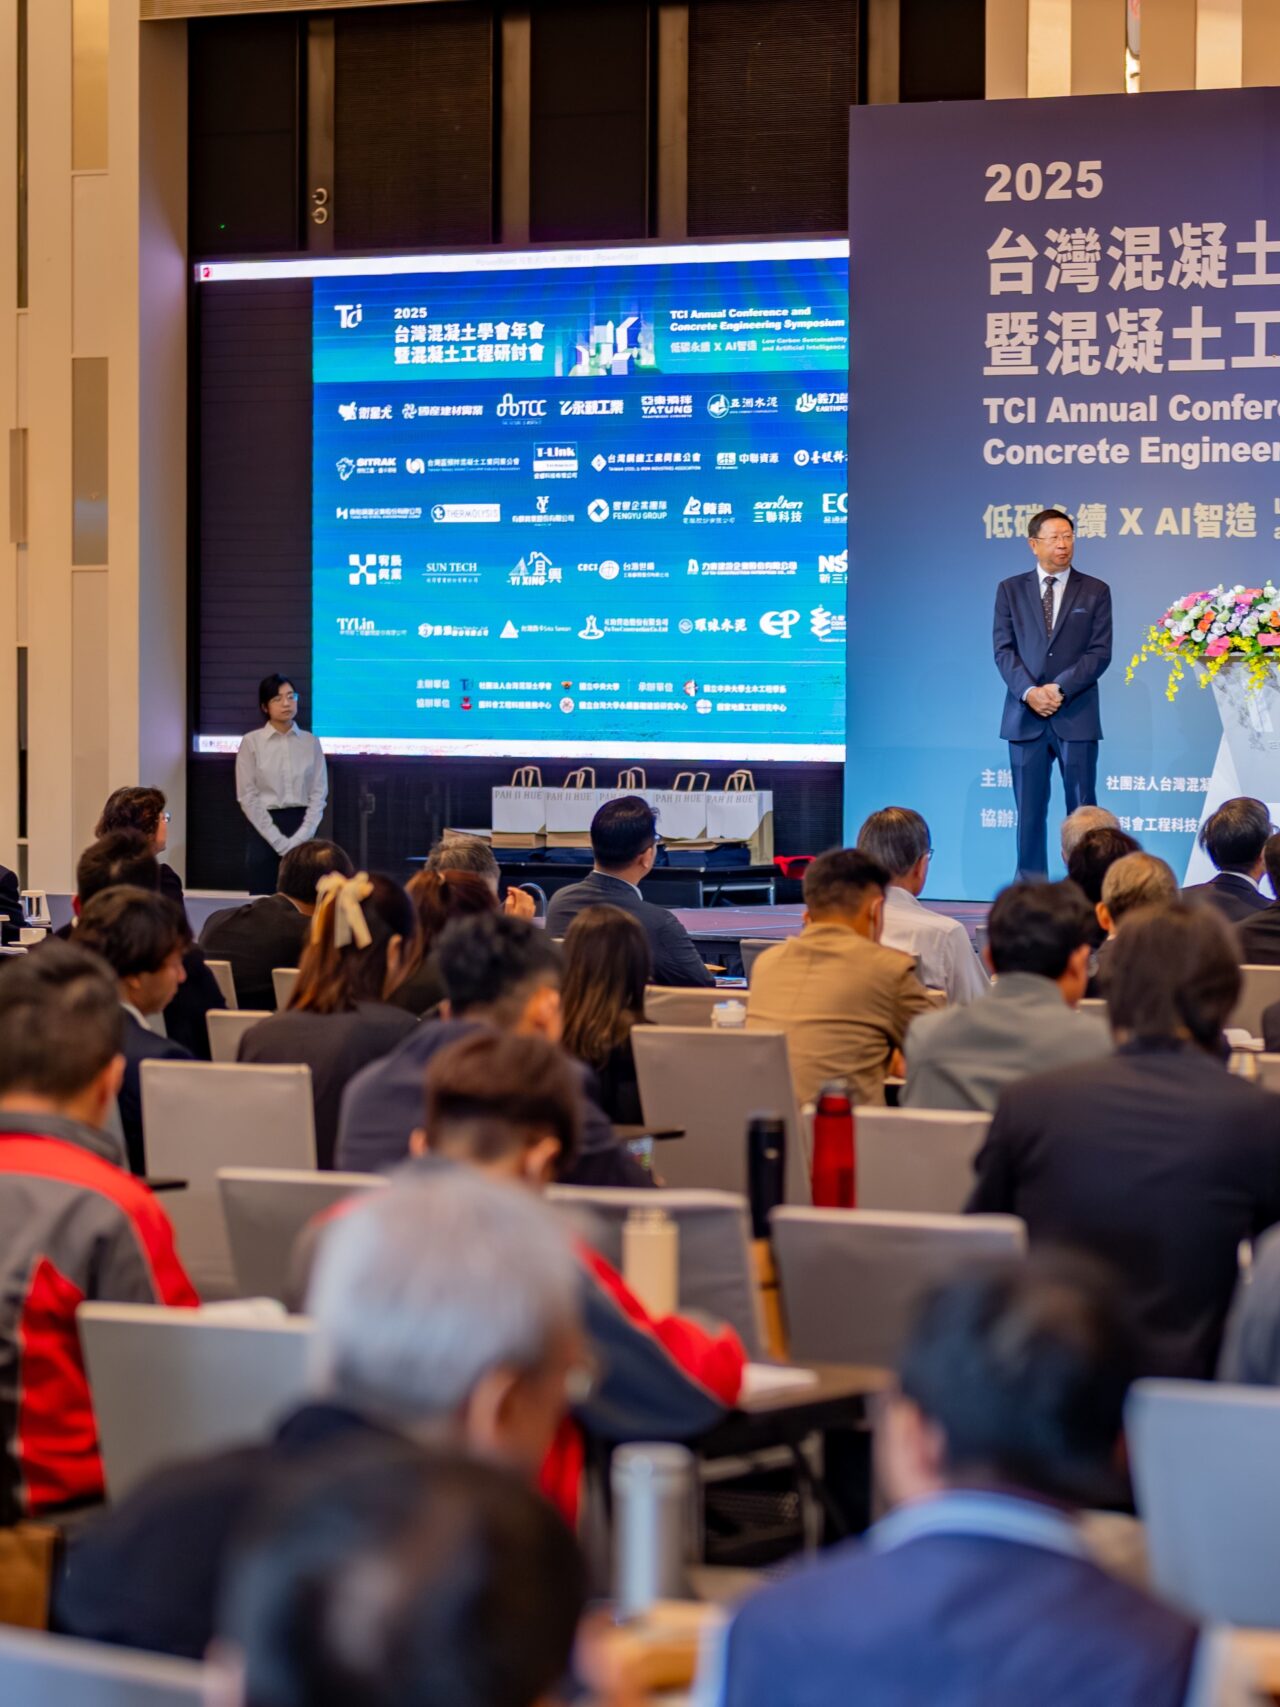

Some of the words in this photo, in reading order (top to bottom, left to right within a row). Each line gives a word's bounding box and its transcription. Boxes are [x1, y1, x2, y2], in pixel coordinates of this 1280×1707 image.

[985, 160, 1103, 202] 2025
[394, 307, 428, 320] 2025
[670, 310, 688, 319] TCI
[690, 309, 726, 319] Annual
[729, 308, 788, 318] Conference
[791, 307, 811, 316] and
[394, 321, 545, 343] 台灣混凝土學會年會
[670, 322, 717, 332] Concrete
[720, 320, 782, 332] Engineering
[784, 319, 845, 330] Symposium
[394, 343, 545, 365] 暨混凝土工程研討會
[641, 406, 692, 415] YATUNG
[983, 396, 1036, 424] TCI
[1046, 395, 1158, 424] Annual
[983, 438, 1130, 465] Concrete
[982, 503, 1107, 539] 低碳續
[1119, 508, 1144, 535] X
[1154, 502, 1257, 538] AI智造
[426, 562, 447, 572] SUN
[449, 562, 478, 572] TECH
[980, 768, 1013, 788] 主辦
[1106, 776, 1212, 793] 社團法人台灣混凝
[980, 808, 1018, 828] 協辦
